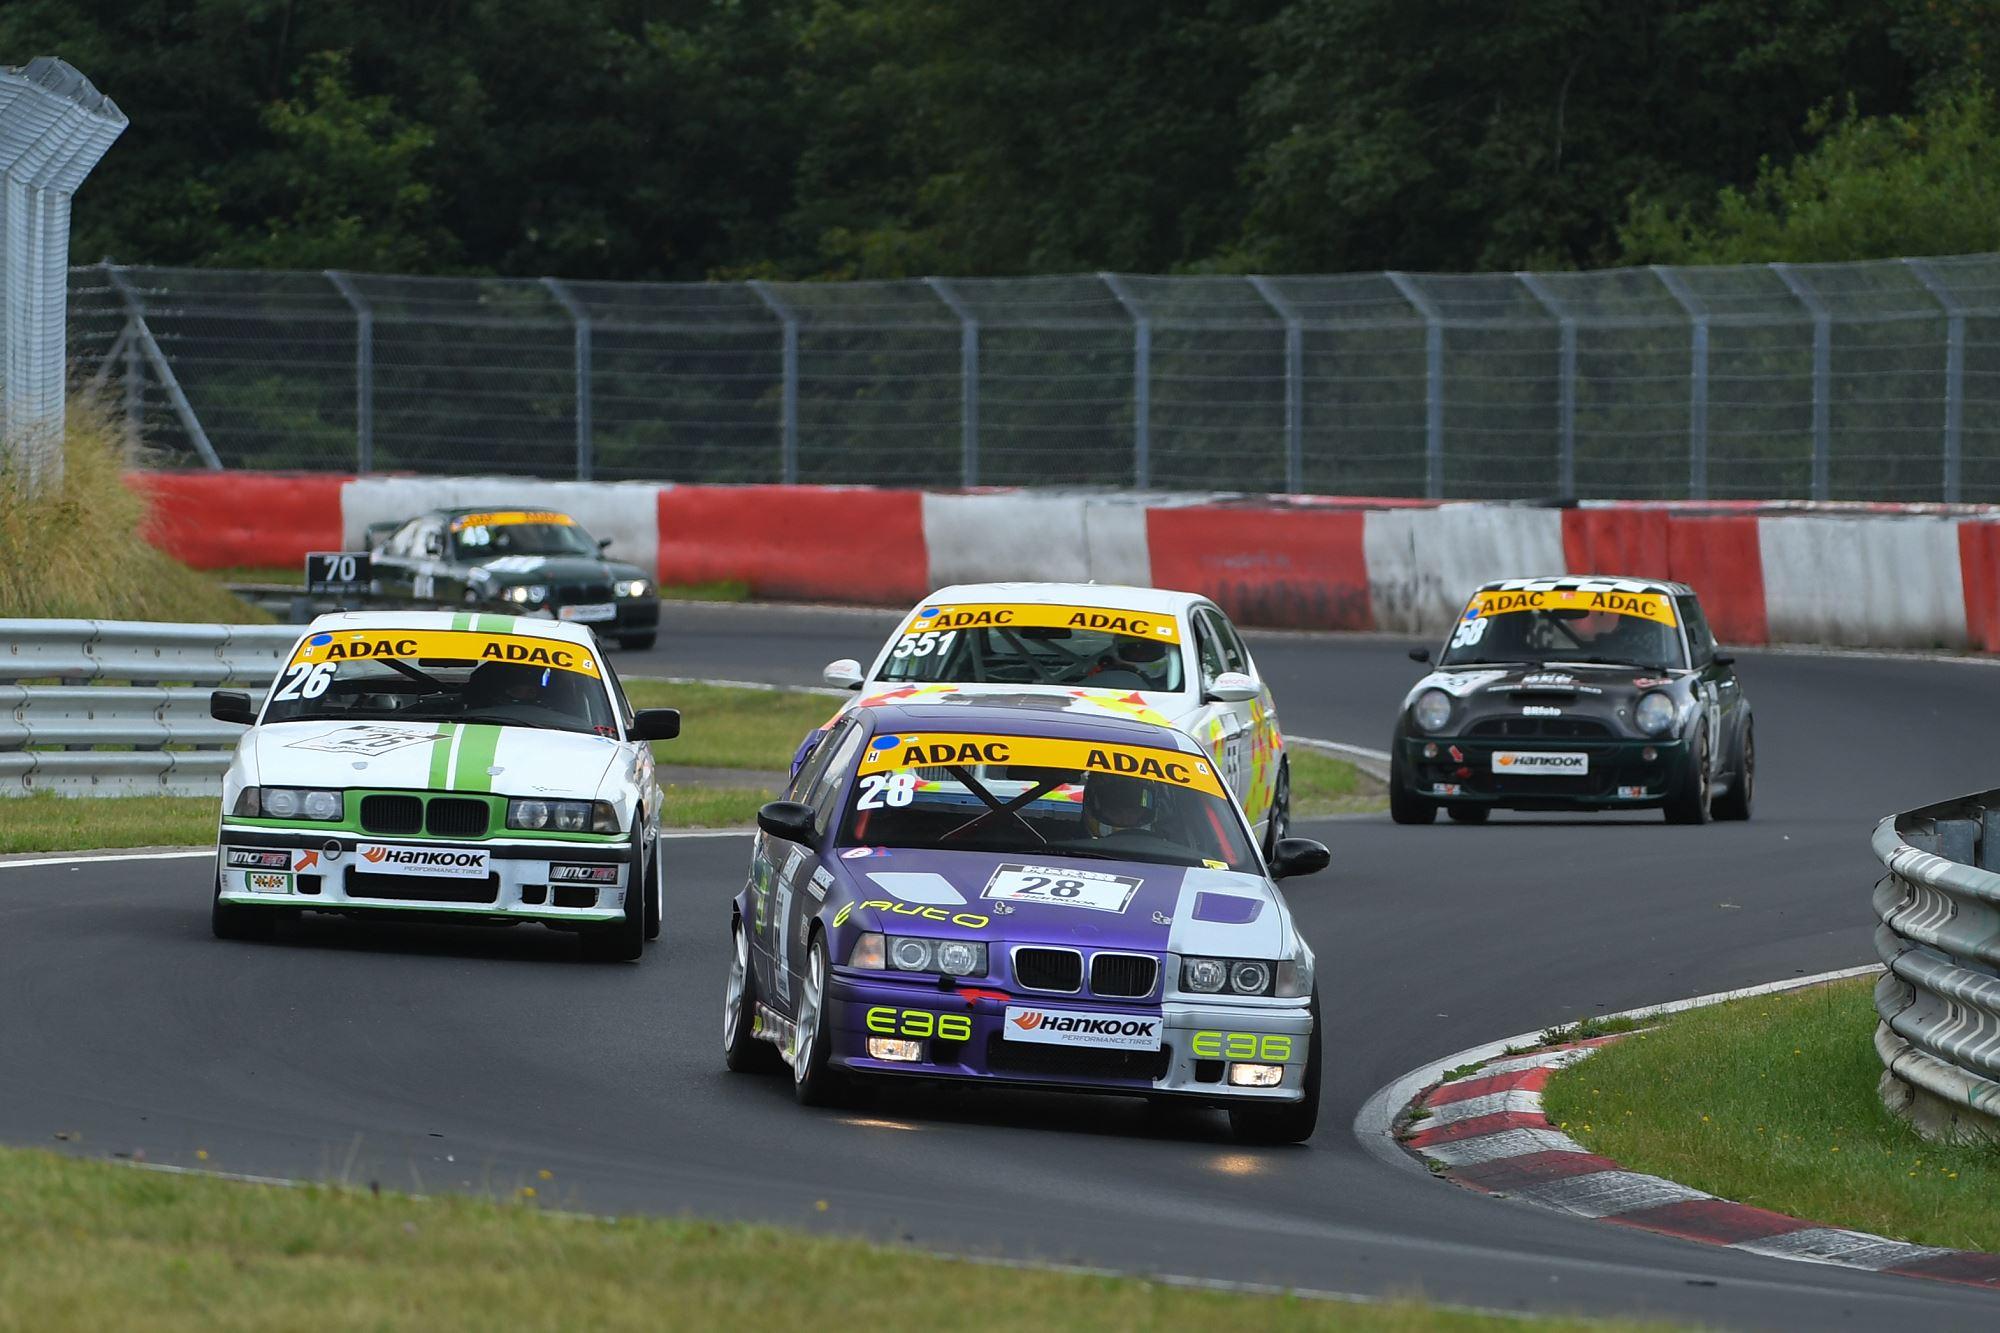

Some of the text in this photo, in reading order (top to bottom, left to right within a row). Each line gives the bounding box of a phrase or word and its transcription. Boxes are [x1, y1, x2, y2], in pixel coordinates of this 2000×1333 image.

[324, 556, 356, 581] 70
[1481, 591, 1545, 614] ADAC
[1591, 591, 1656, 616] ADAC
[934, 610, 1014, 628] ADAC
[1068, 612, 1149, 635] ADAC
[893, 631, 957, 658] 551
[1451, 618, 1488, 649] 58
[303, 647, 313, 656] H
[326, 640, 418, 661] ADAC
[482, 642, 573, 668] ADAC
[275, 661, 337, 701] 26
[868, 752, 878, 762] H
[901, 743, 1009, 766] ADAC
[1086, 749, 1190, 784] ADAC
[856, 774, 916, 810] 28
[404, 865, 460, 875] PERFORMANCE
[1015, 876, 1085, 898] 28
[866, 1006, 971, 1041] E36
[1062, 1033, 1153, 1047] PERFORMANCE TIRES
[1192, 1031, 1292, 1061] E36
